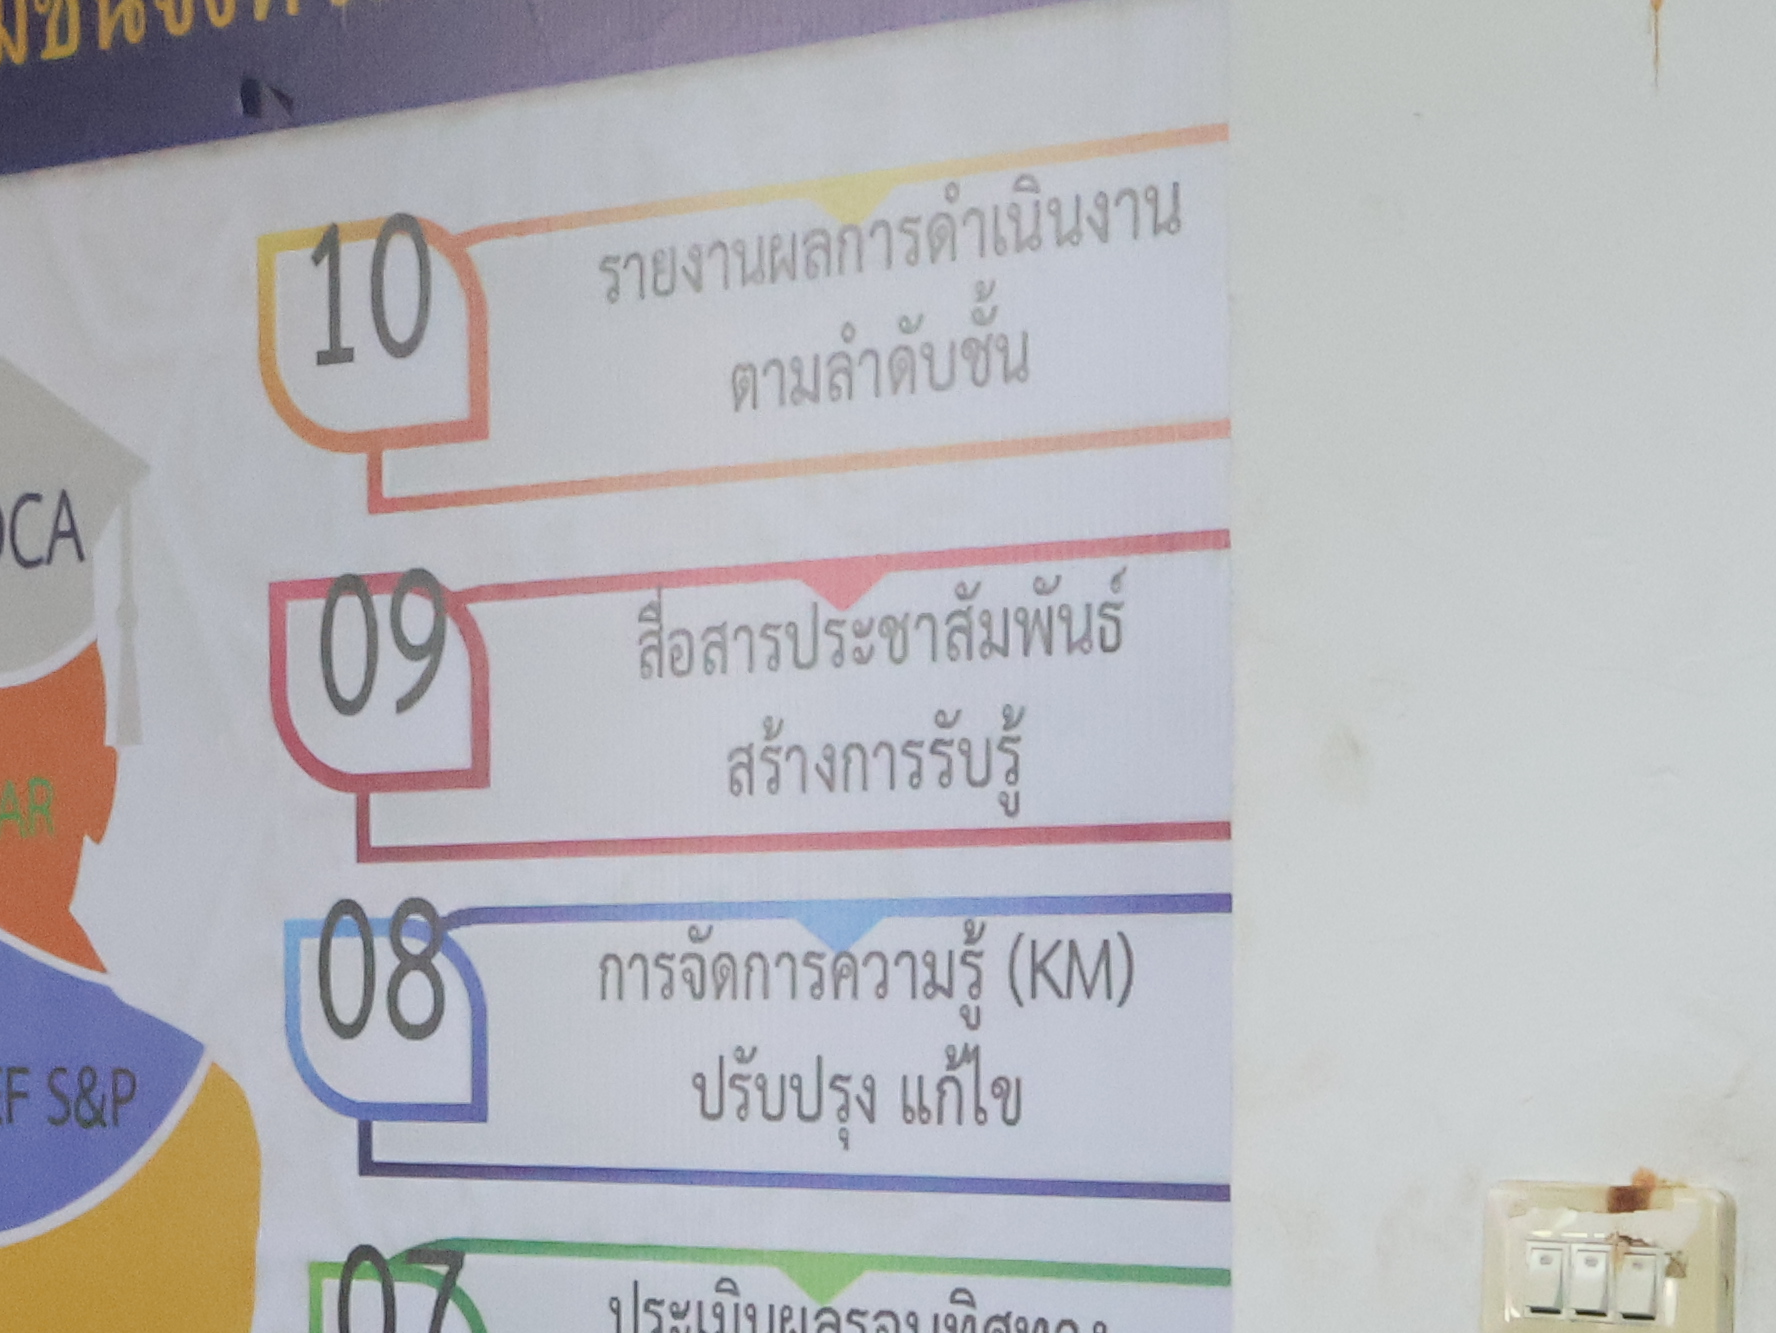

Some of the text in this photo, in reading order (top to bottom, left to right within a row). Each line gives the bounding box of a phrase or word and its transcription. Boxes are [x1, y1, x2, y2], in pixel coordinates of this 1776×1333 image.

[309, 211, 433, 367] 10
[597, 175, 1184, 305] รายงานผลการดำเนินงาน
[730, 280, 1031, 414] ตามลำดับชั้น
[318, 566, 449, 717] 09
[635, 567, 1128, 682] สื่อสารประชาสัมพันธ์
[726, 703, 1024, 818] สร้างการรับรู้
[317, 896, 446, 1041] 08
[597, 920, 1136, 1033] การจัดการความรู้ (KM)
[48, 1066, 138, 1129] S&P
[691, 1043, 1024, 1151] ปรับปรุง แก้ไข
